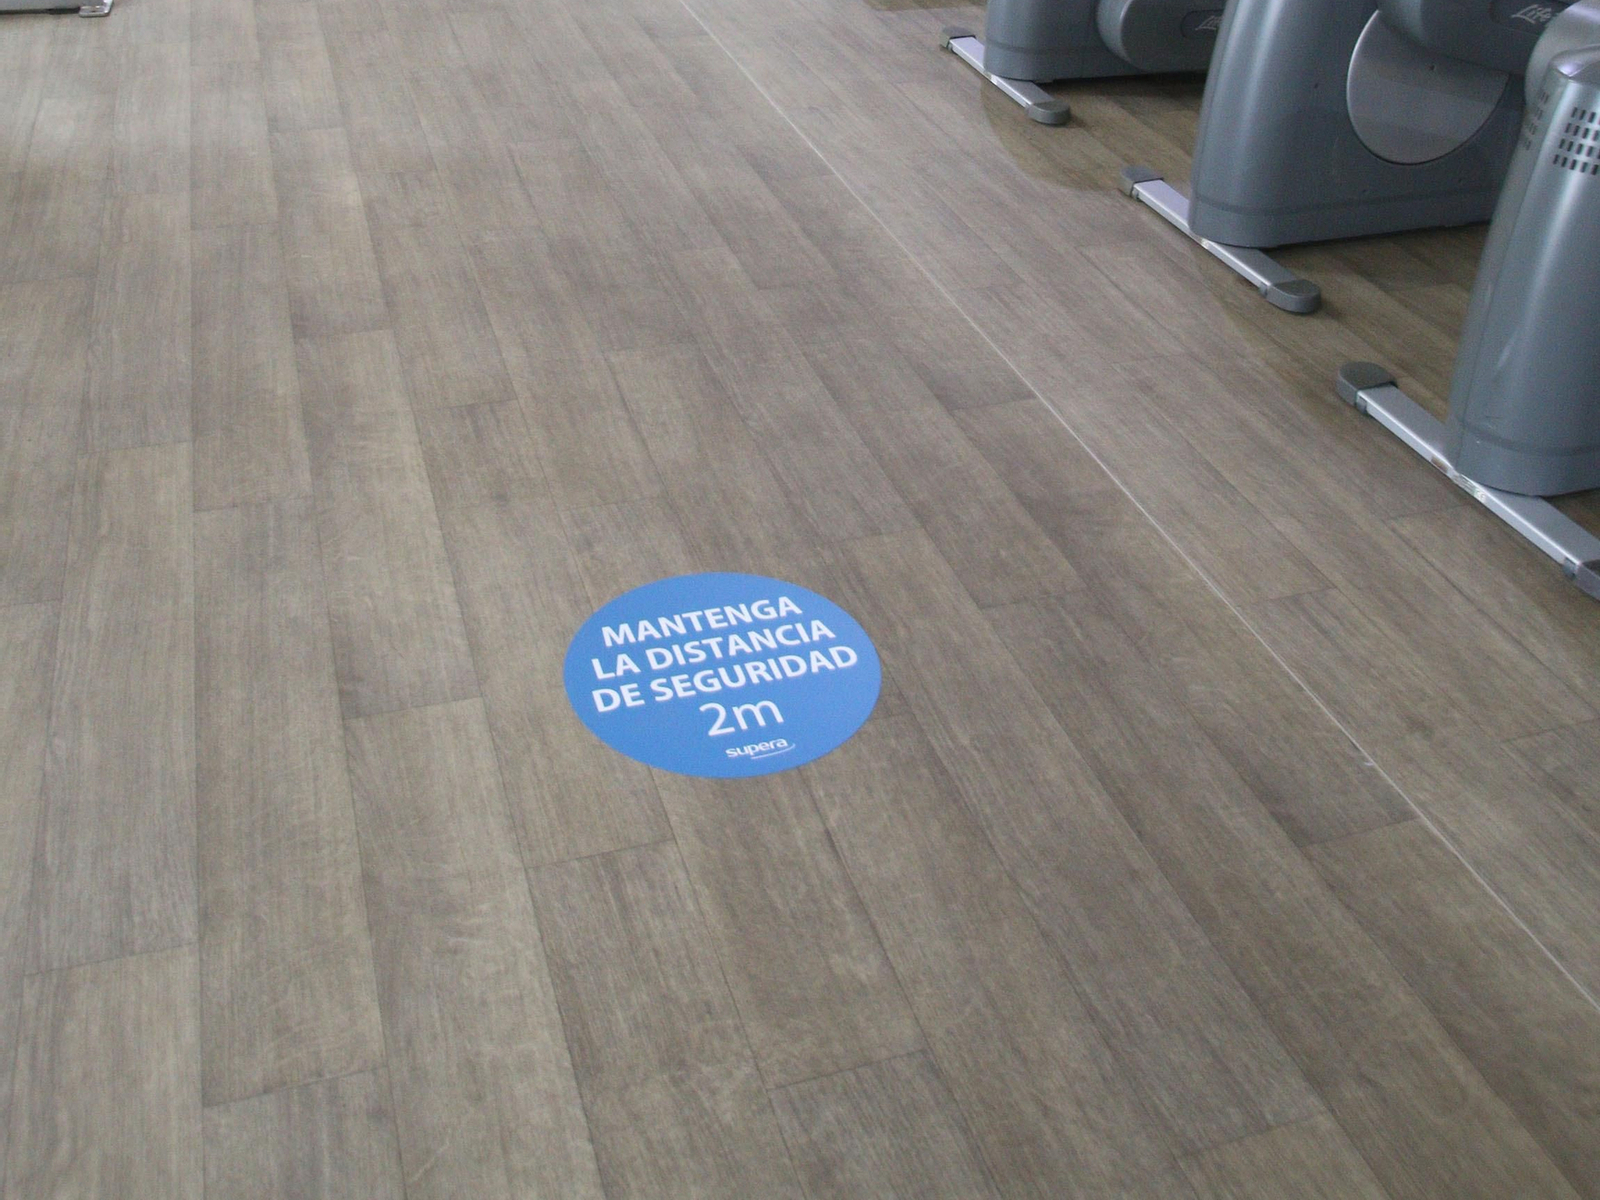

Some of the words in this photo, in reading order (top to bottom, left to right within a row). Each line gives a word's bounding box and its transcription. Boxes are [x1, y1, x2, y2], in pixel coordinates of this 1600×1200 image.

[601, 596, 802, 647] MANTENGA
[591, 653, 641, 680] LA
[645, 619, 836, 670] DISTANCIA
[591, 683, 645, 713] DE
[649, 645, 858, 702] SEGURIDAD
[699, 699, 784, 737] 2m
[725, 738, 788, 758] supera
